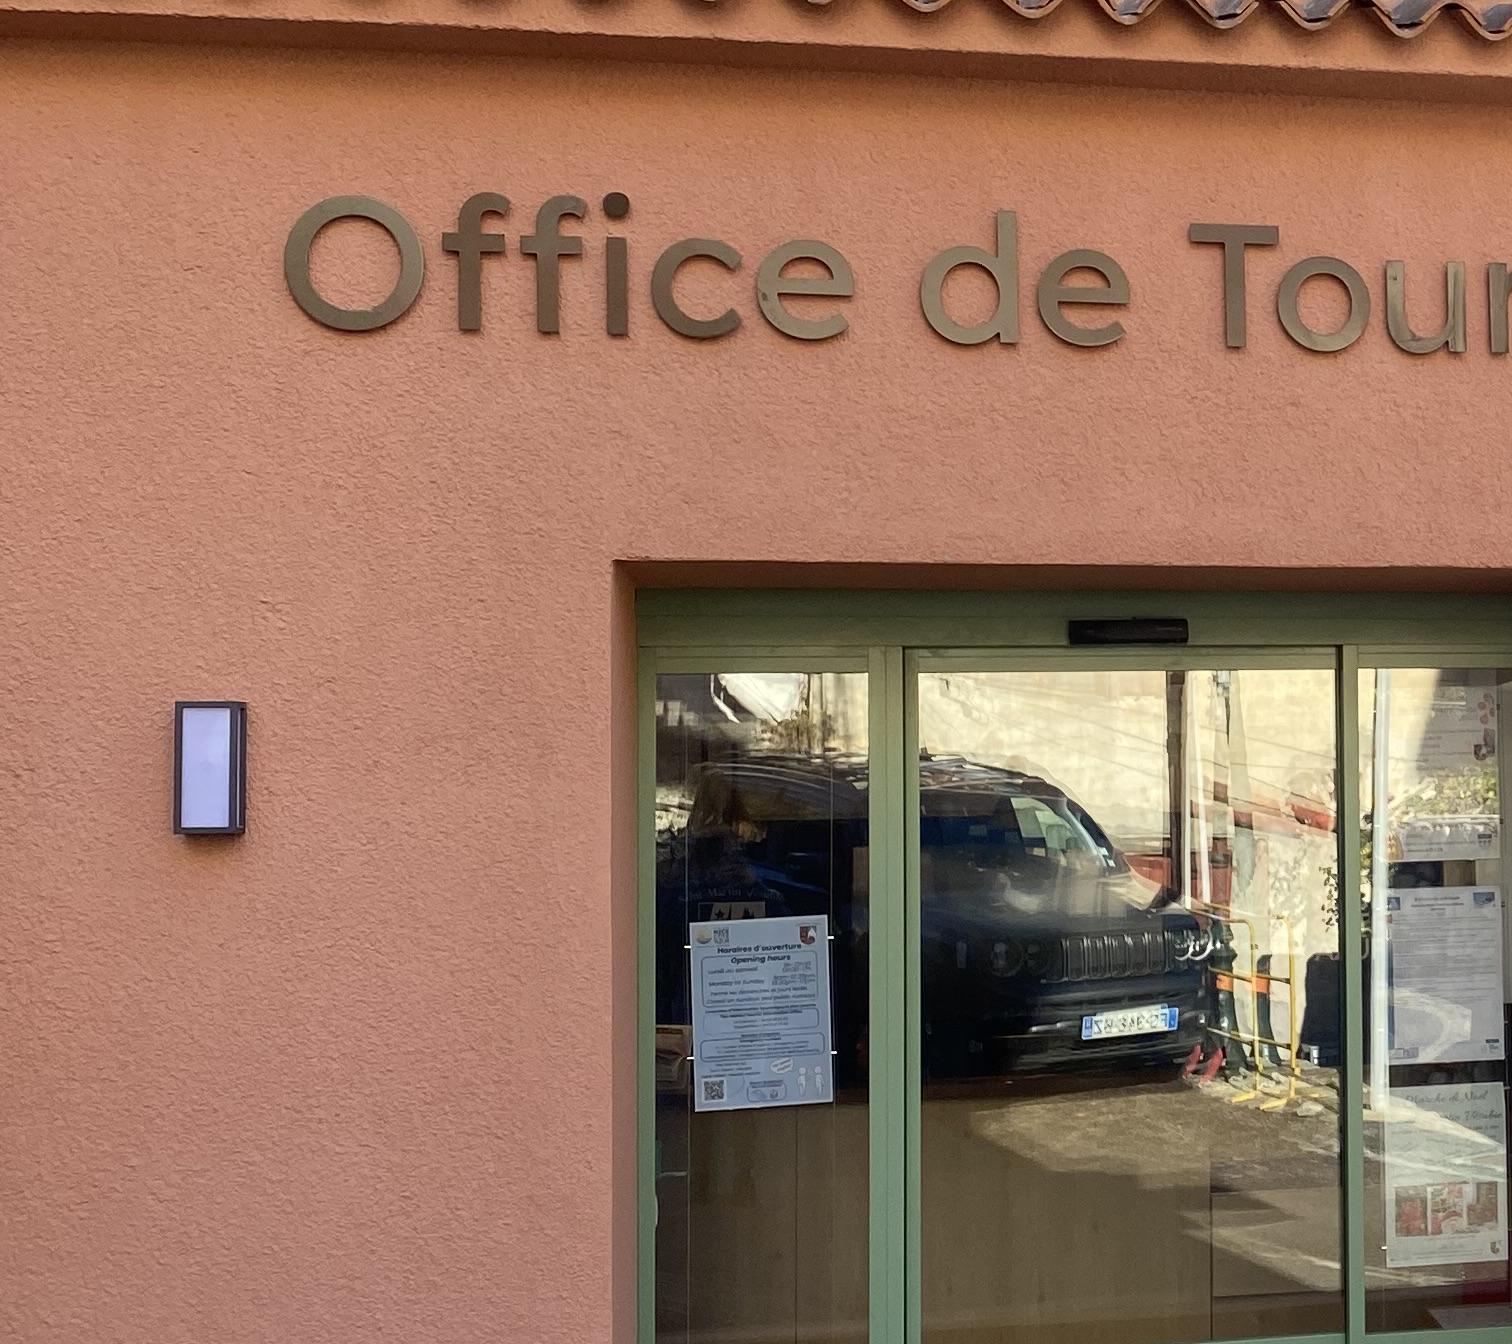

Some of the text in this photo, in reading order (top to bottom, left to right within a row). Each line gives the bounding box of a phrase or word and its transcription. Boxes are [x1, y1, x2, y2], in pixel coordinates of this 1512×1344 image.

[283, 192, 855, 340] Office
[919, 209, 1131, 347] de
[717, 944, 802, 954] Horaires d'ouverture
[731, 955, 765, 966] Opening
